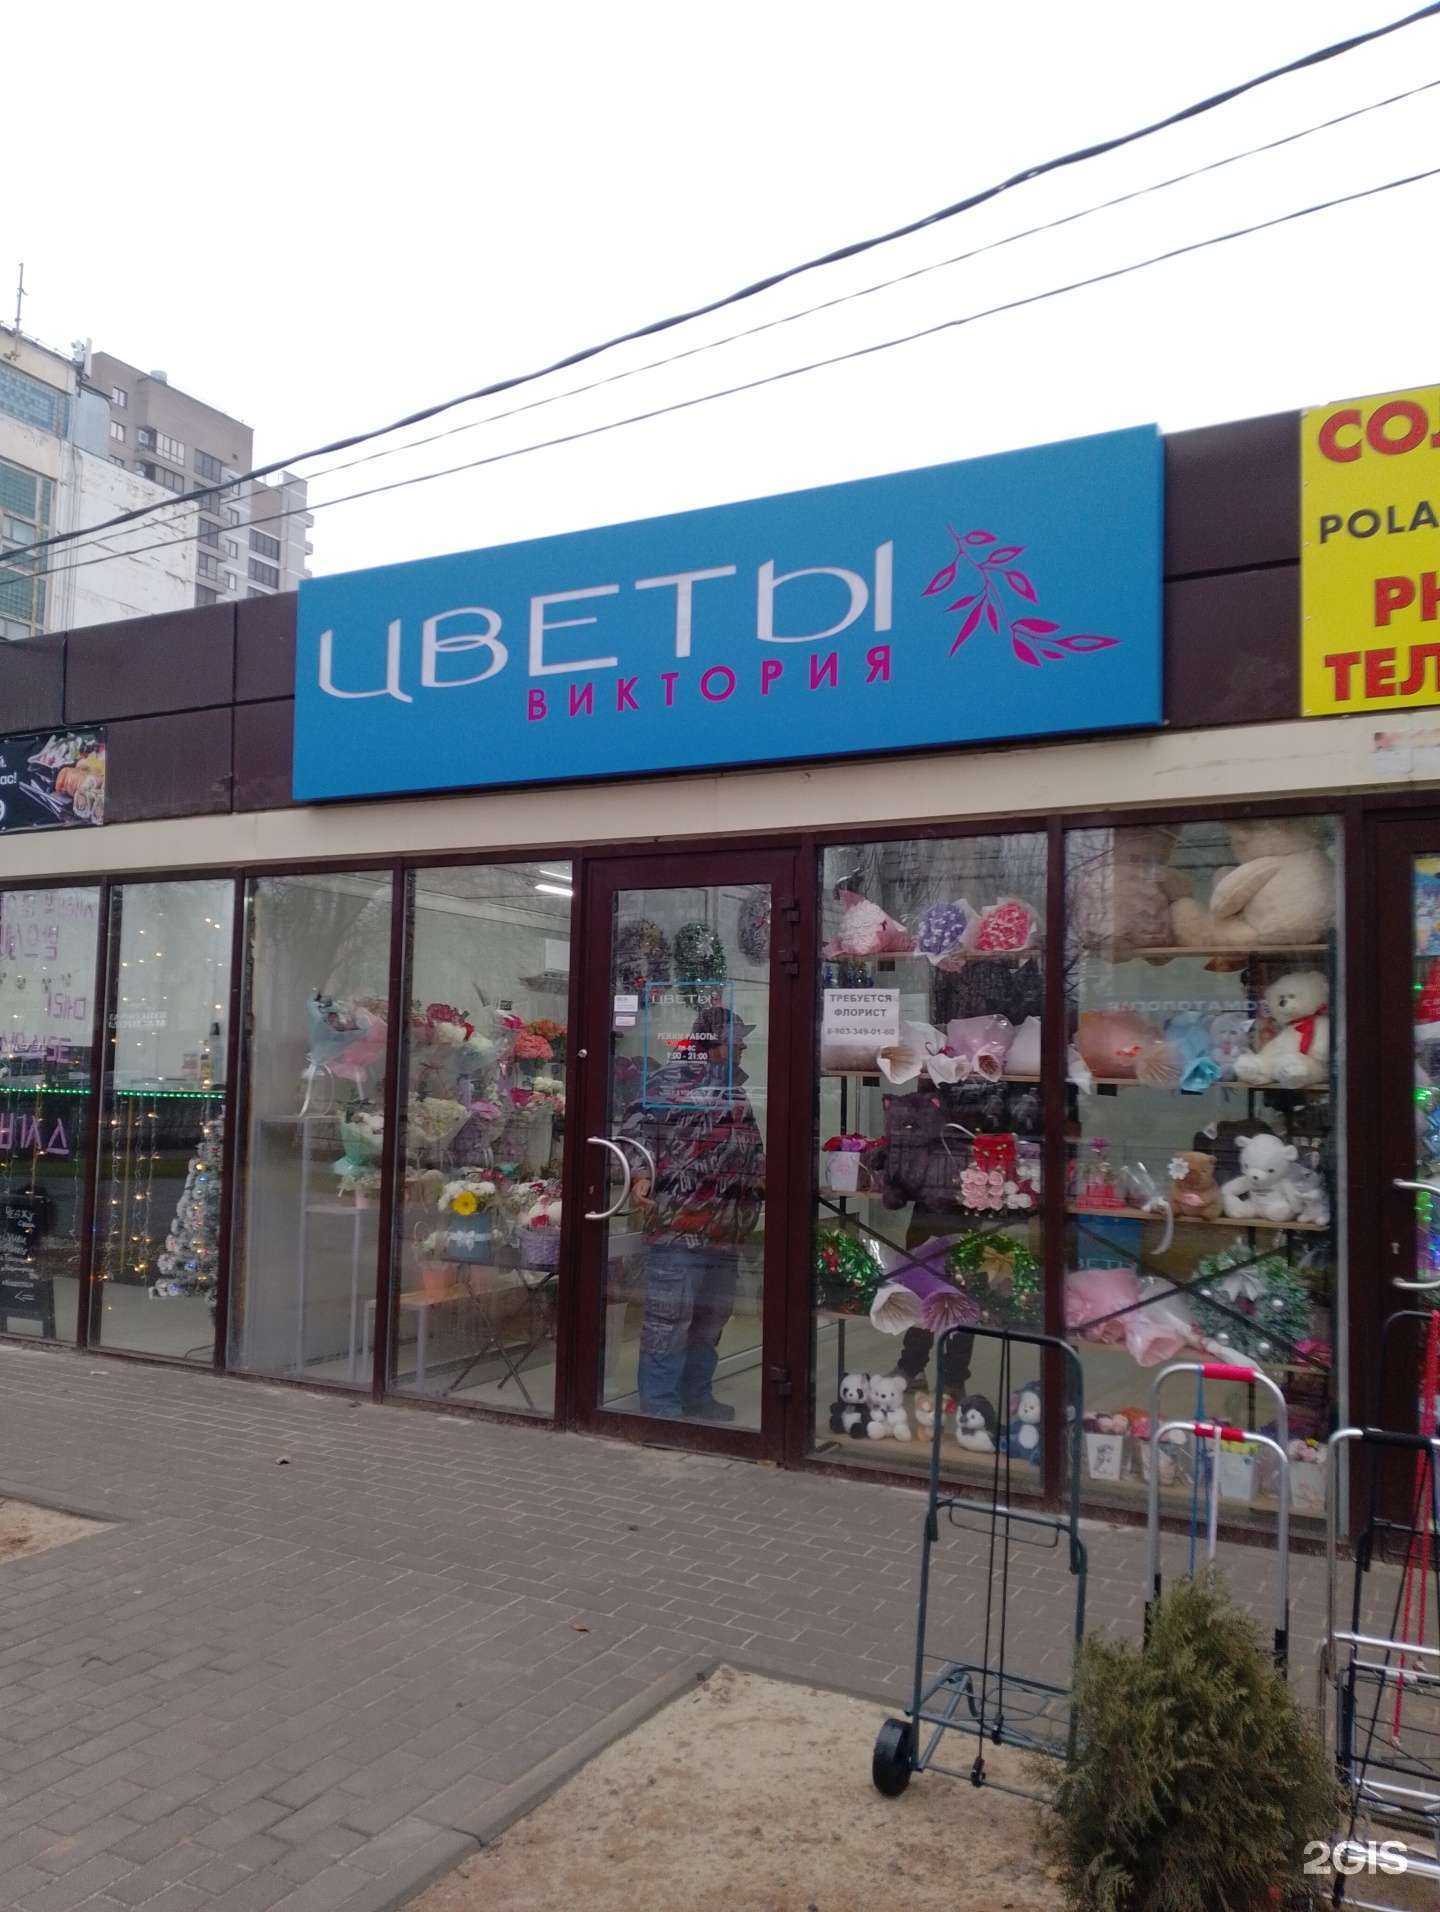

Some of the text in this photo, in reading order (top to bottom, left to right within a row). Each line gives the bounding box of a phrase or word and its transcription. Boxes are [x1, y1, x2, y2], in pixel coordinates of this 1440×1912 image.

[1319, 400, 1440, 463] СО
[318, 541, 893, 704] ЦВЕТЫ
[527, 645, 893, 721] ВИКТОРИЯ
[830, 994, 892, 1002] ТРЕБУЕТСЯ
[834, 1008, 887, 1017] ФЛОРИСТ
